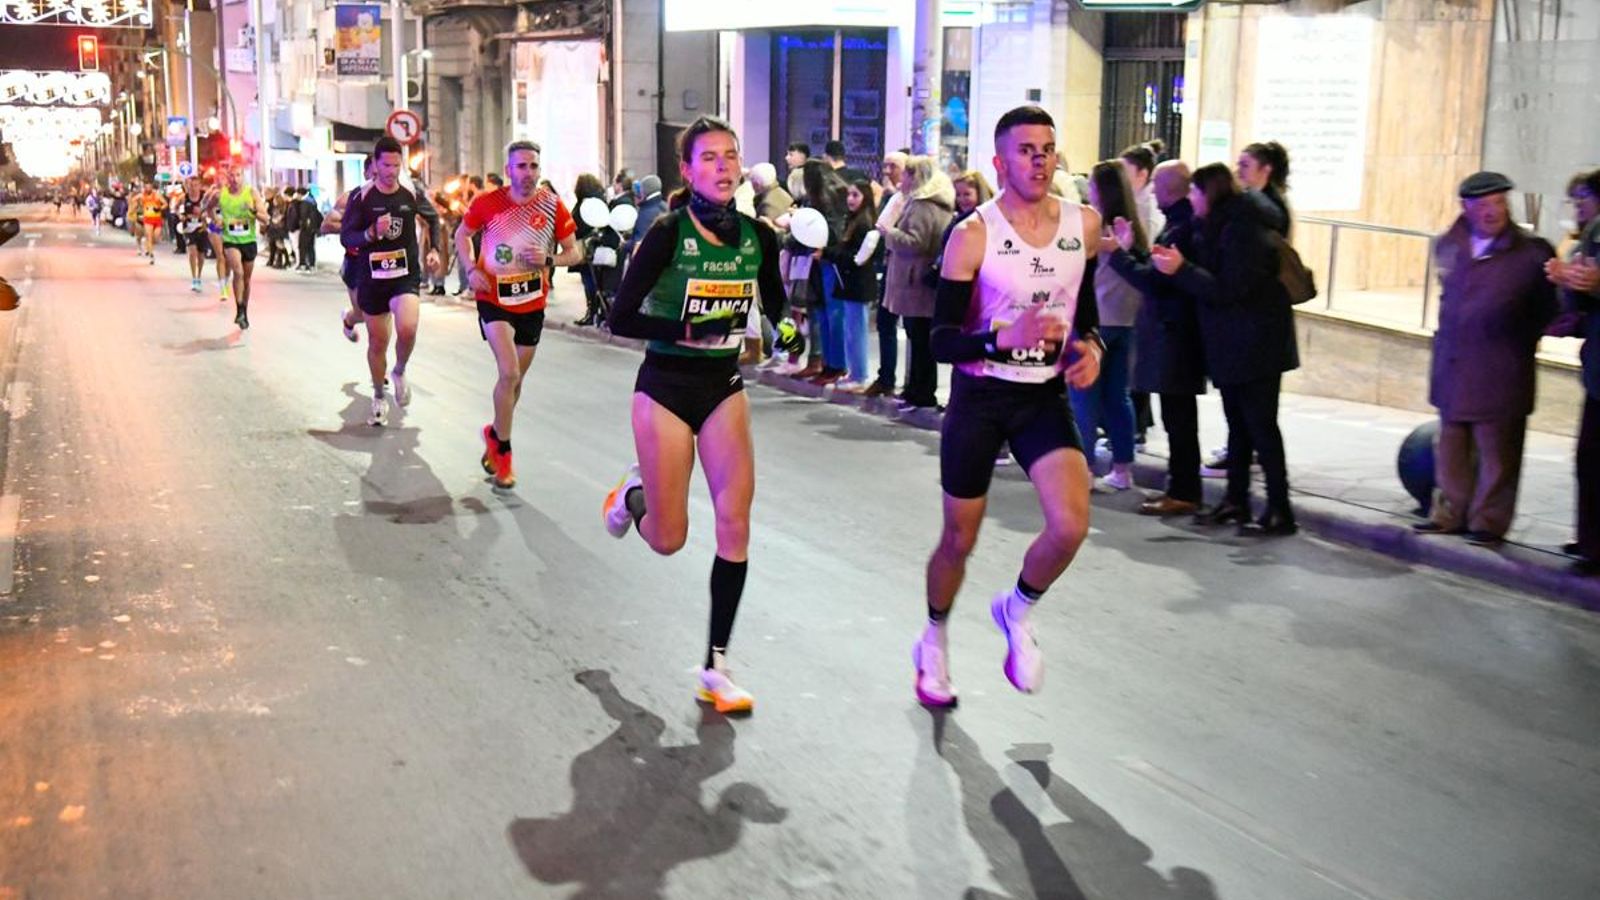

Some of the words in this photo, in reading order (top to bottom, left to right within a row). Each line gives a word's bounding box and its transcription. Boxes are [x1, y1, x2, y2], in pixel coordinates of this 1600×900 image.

[381, 258, 397, 269] 62
[511, 281, 529, 294] 81
[688, 298, 749, 315] BLANCA
